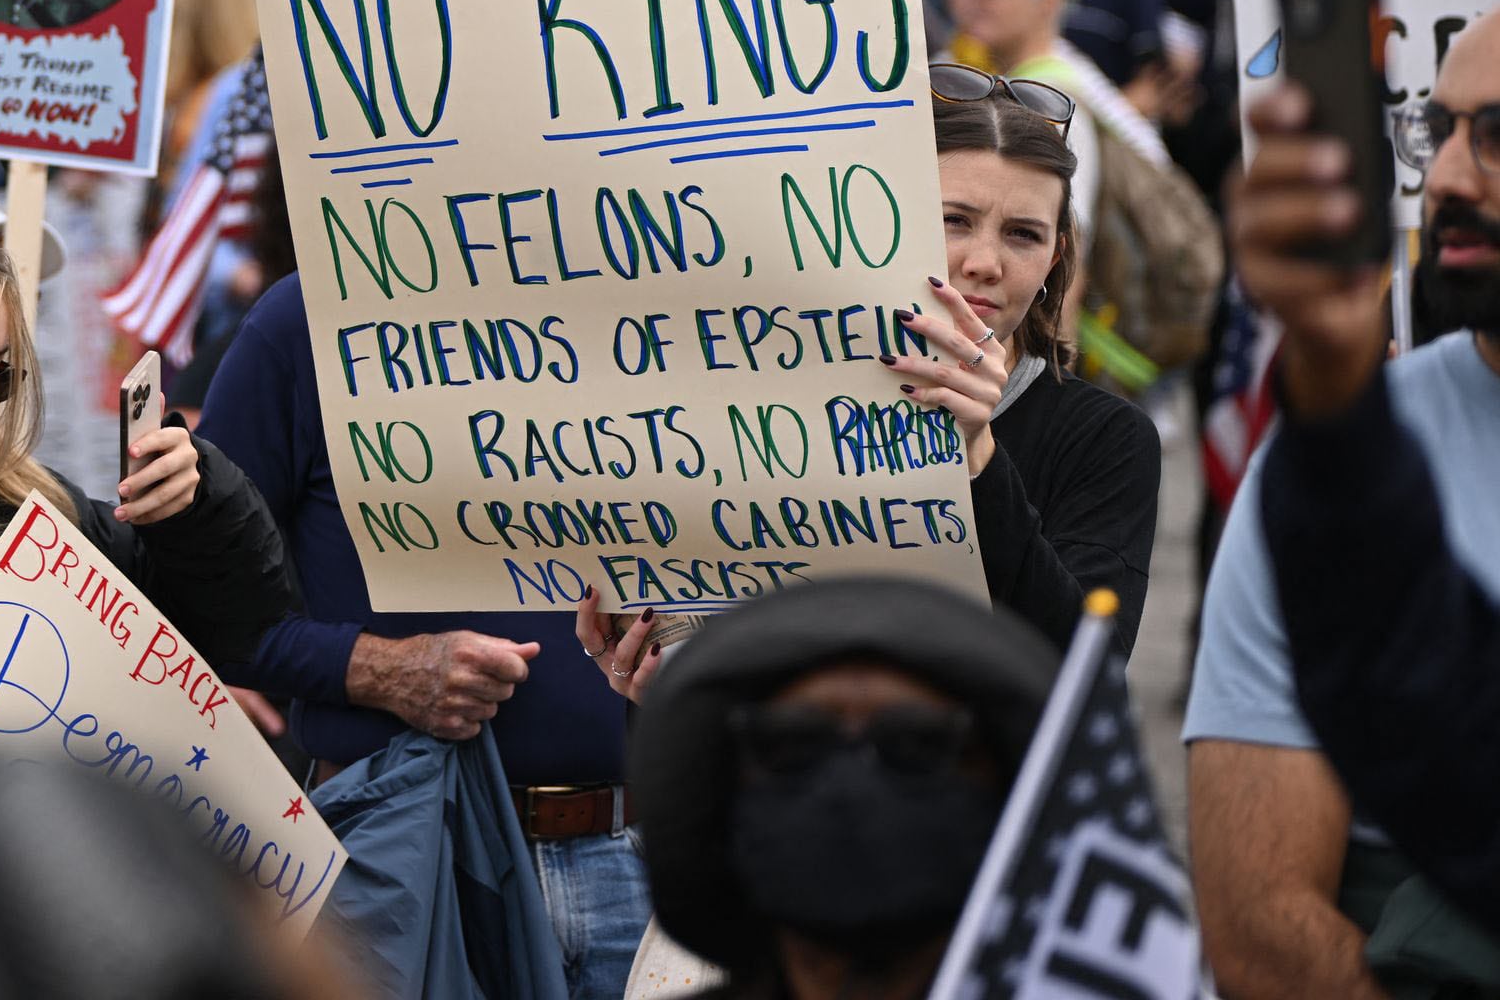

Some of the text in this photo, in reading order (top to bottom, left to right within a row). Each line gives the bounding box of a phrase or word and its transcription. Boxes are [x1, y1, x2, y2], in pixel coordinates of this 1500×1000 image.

[19, 52, 94, 75] TRUMP
[32, 76, 114, 102] REGIME
[0, 99, 22, 115] GO
[26, 99, 98, 126] NOW!
[320, 163, 901, 301] NO FELONS, NO
[338, 313, 580, 396] FRIENDS
[614, 313, 674, 376] OF
[347, 419, 434, 484] NO
[468, 405, 724, 487] RACISTS,
[728, 403, 809, 482] NO
[357, 496, 973, 554] NO CROOKED CABINETS,
[503, 557, 587, 606] NO
[129, 620, 230, 730] BACK
